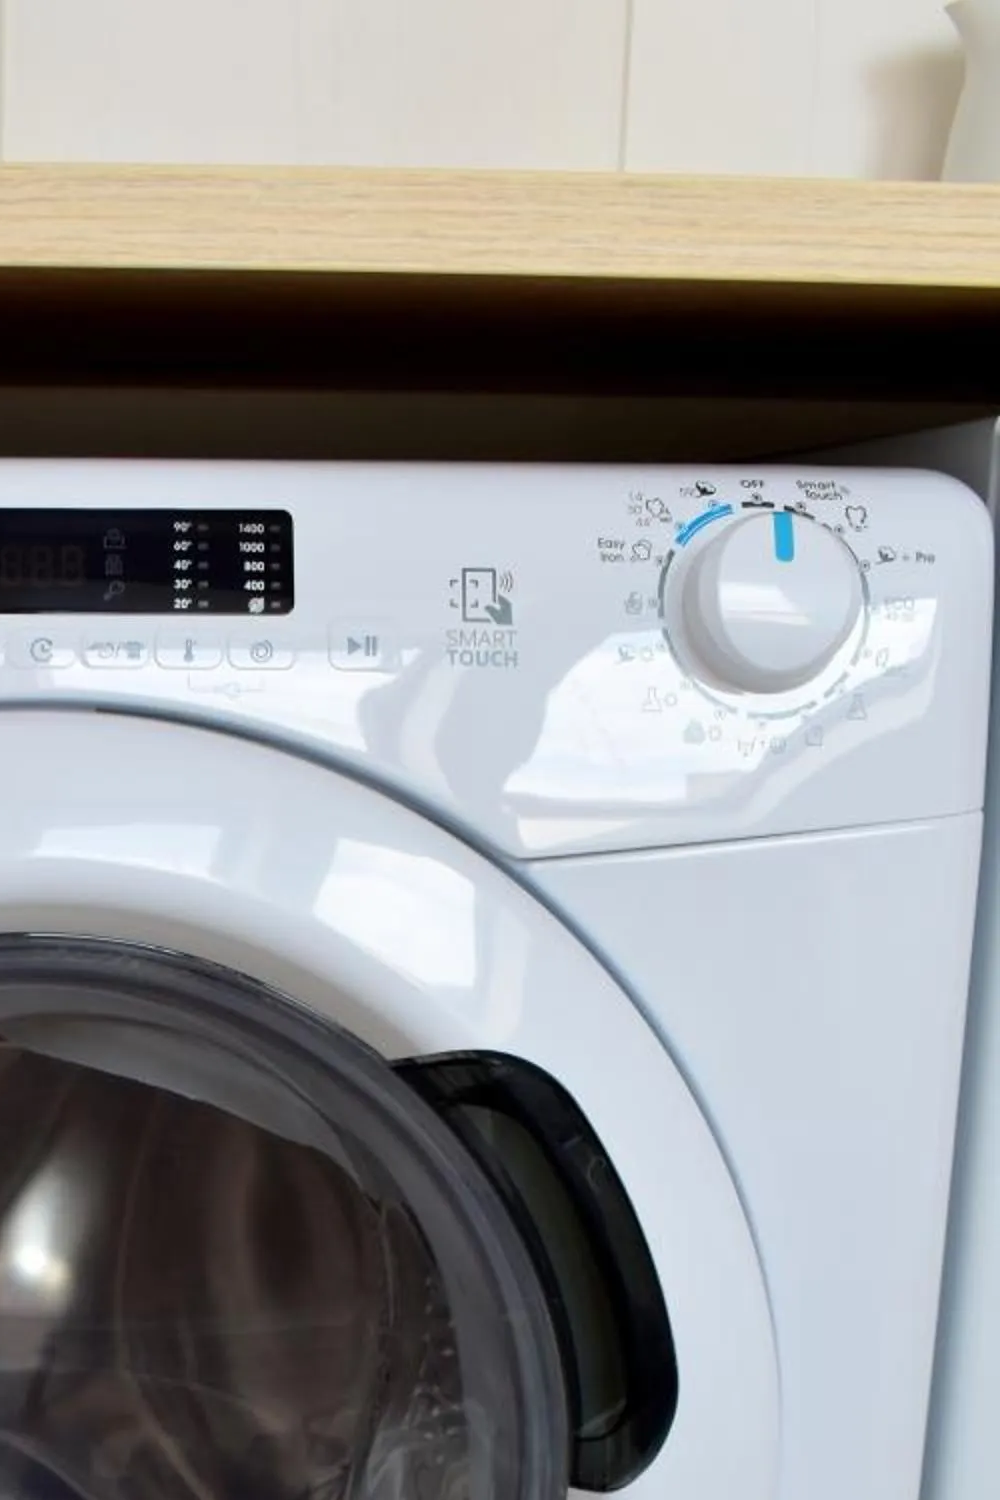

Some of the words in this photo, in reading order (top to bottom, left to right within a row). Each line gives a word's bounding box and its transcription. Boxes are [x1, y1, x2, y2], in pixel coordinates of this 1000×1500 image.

[238, 522, 265, 534] 1400
[238, 541, 265, 553] 1000
[243, 560, 265, 572] 800
[243, 579, 265, 591] 400
[445, 628, 518, 648] SMART
[446, 649, 519, 669] TOUCH
